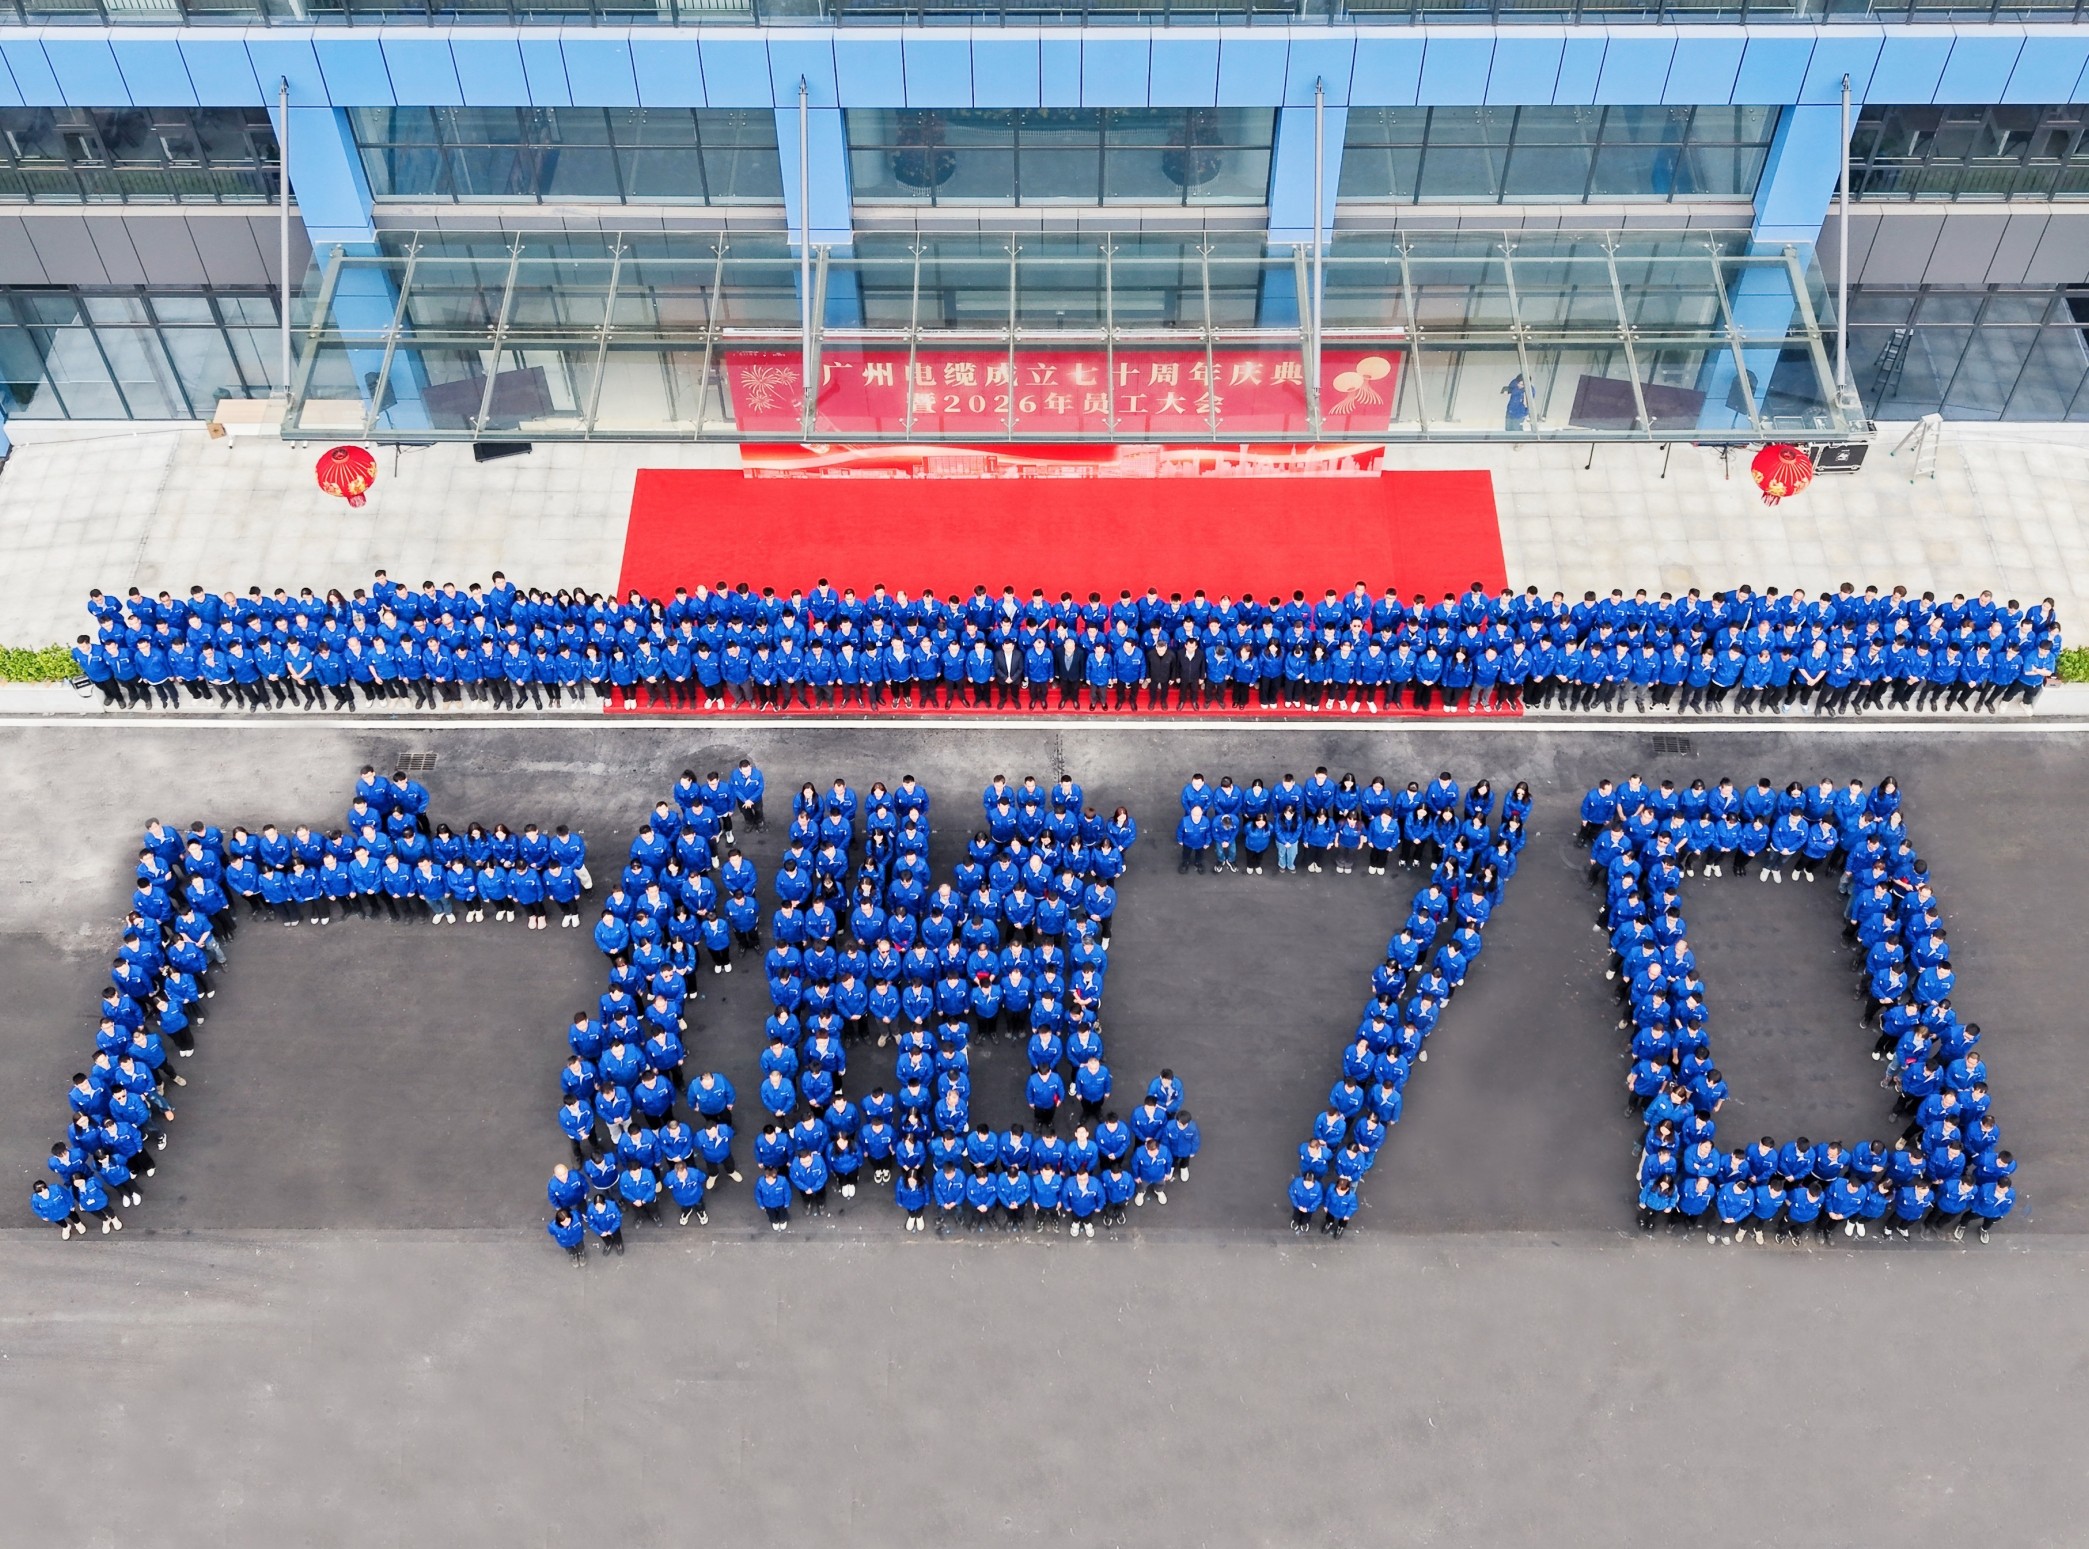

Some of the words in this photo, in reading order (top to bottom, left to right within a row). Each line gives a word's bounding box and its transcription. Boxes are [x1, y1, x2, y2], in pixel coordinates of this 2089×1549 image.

[822, 361, 1304, 387] 广州电缆成立七十周年庆典
[906, 391, 1225, 415] 暨2026年员工大会
